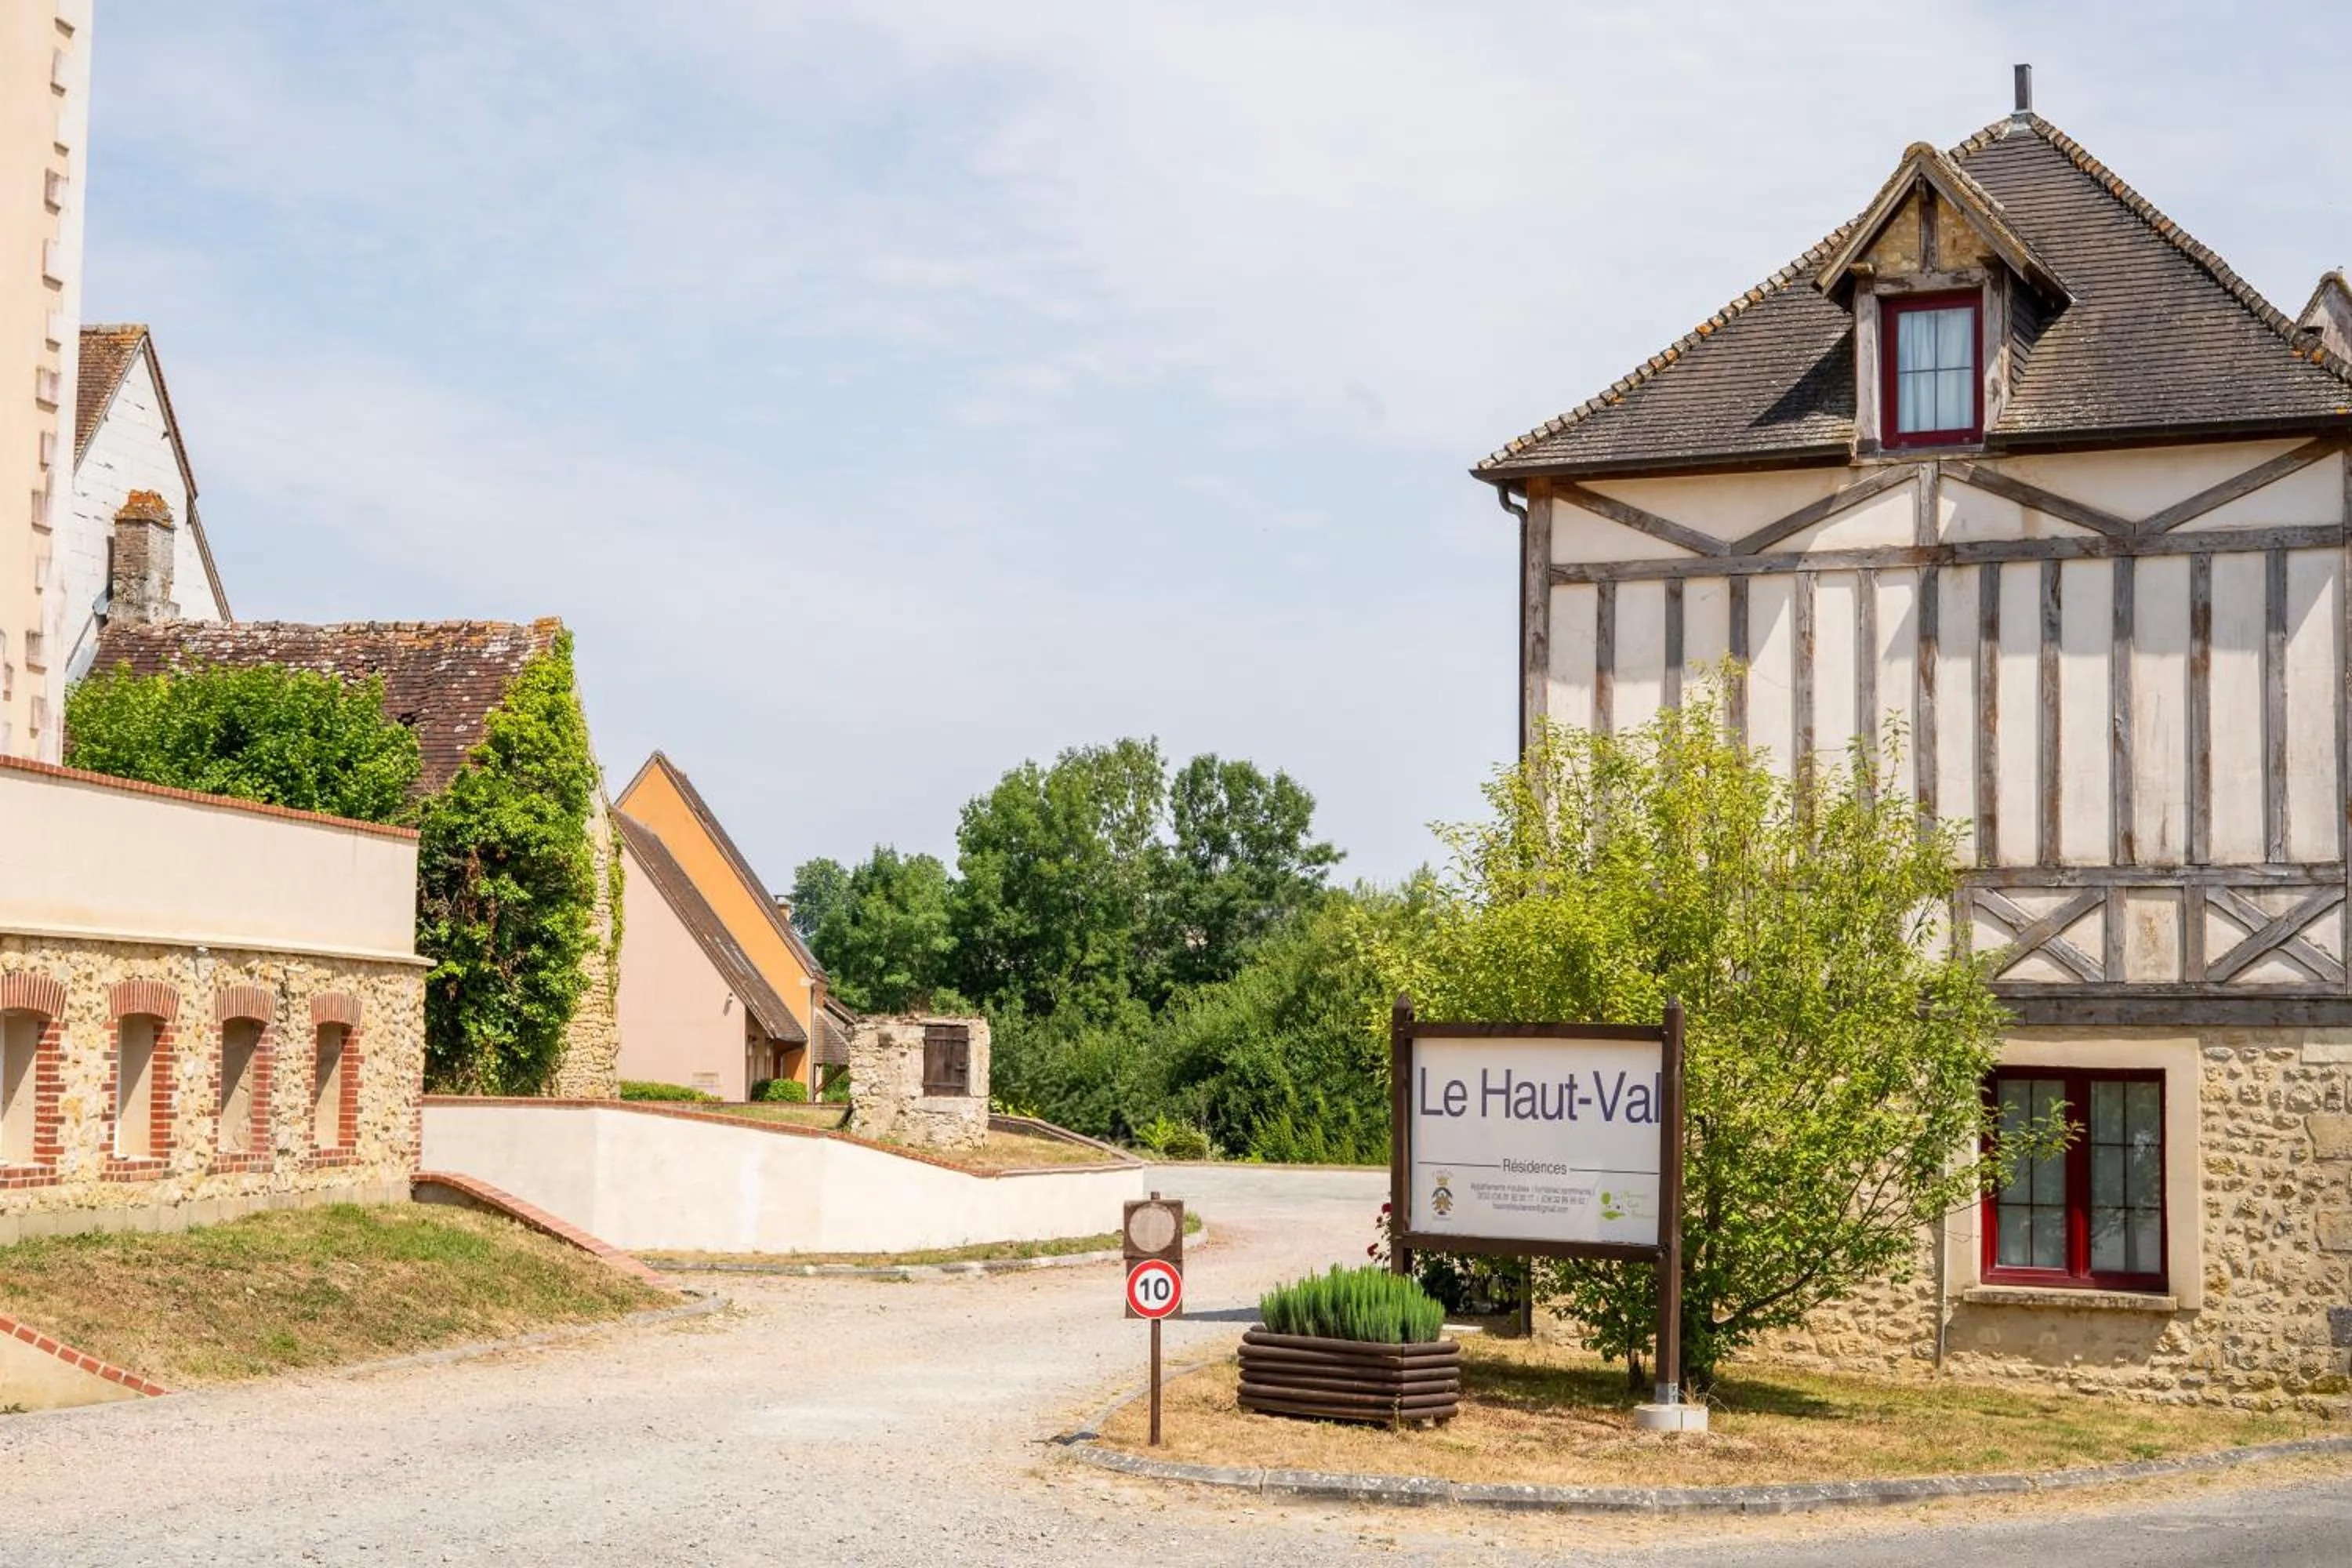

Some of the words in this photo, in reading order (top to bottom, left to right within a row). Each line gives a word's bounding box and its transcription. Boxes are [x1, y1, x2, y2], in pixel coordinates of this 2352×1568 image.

[1420, 1067, 1468, 1117] Le
[1481, 1068, 1661, 1123] Haut-Val
[1503, 1158, 1567, 1175] Résidences
[1140, 1278, 1170, 1301] 10
